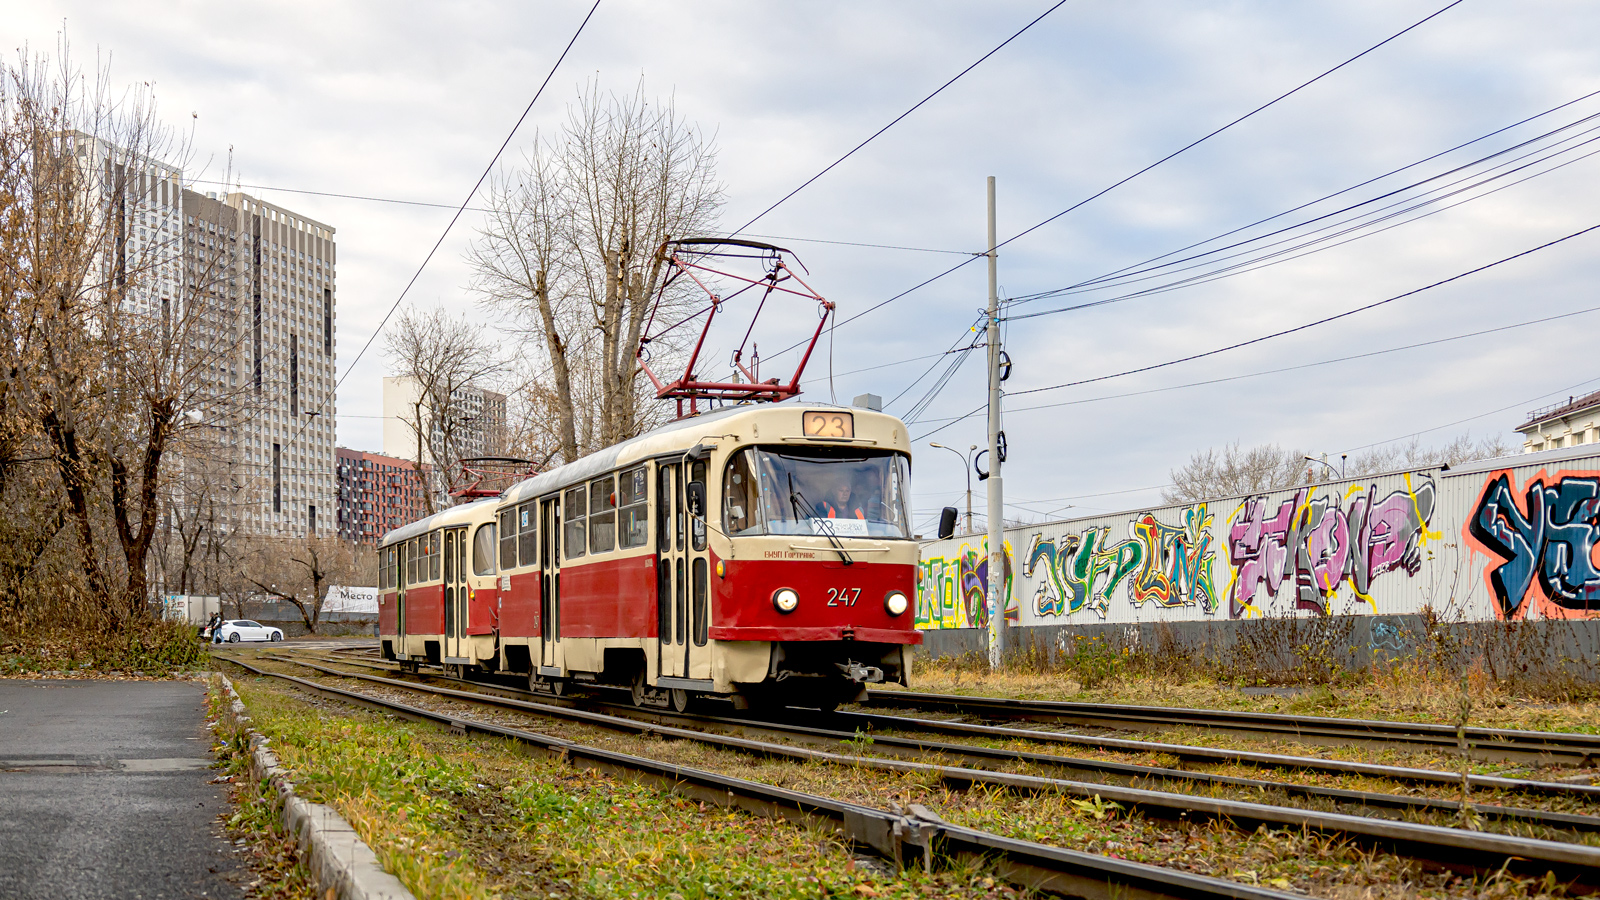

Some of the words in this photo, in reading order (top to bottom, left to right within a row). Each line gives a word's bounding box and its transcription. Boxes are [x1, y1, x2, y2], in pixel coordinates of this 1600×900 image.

[812, 415, 846, 438] 23
[340, 591, 373, 600] Место
[827, 587, 862, 607] 247
